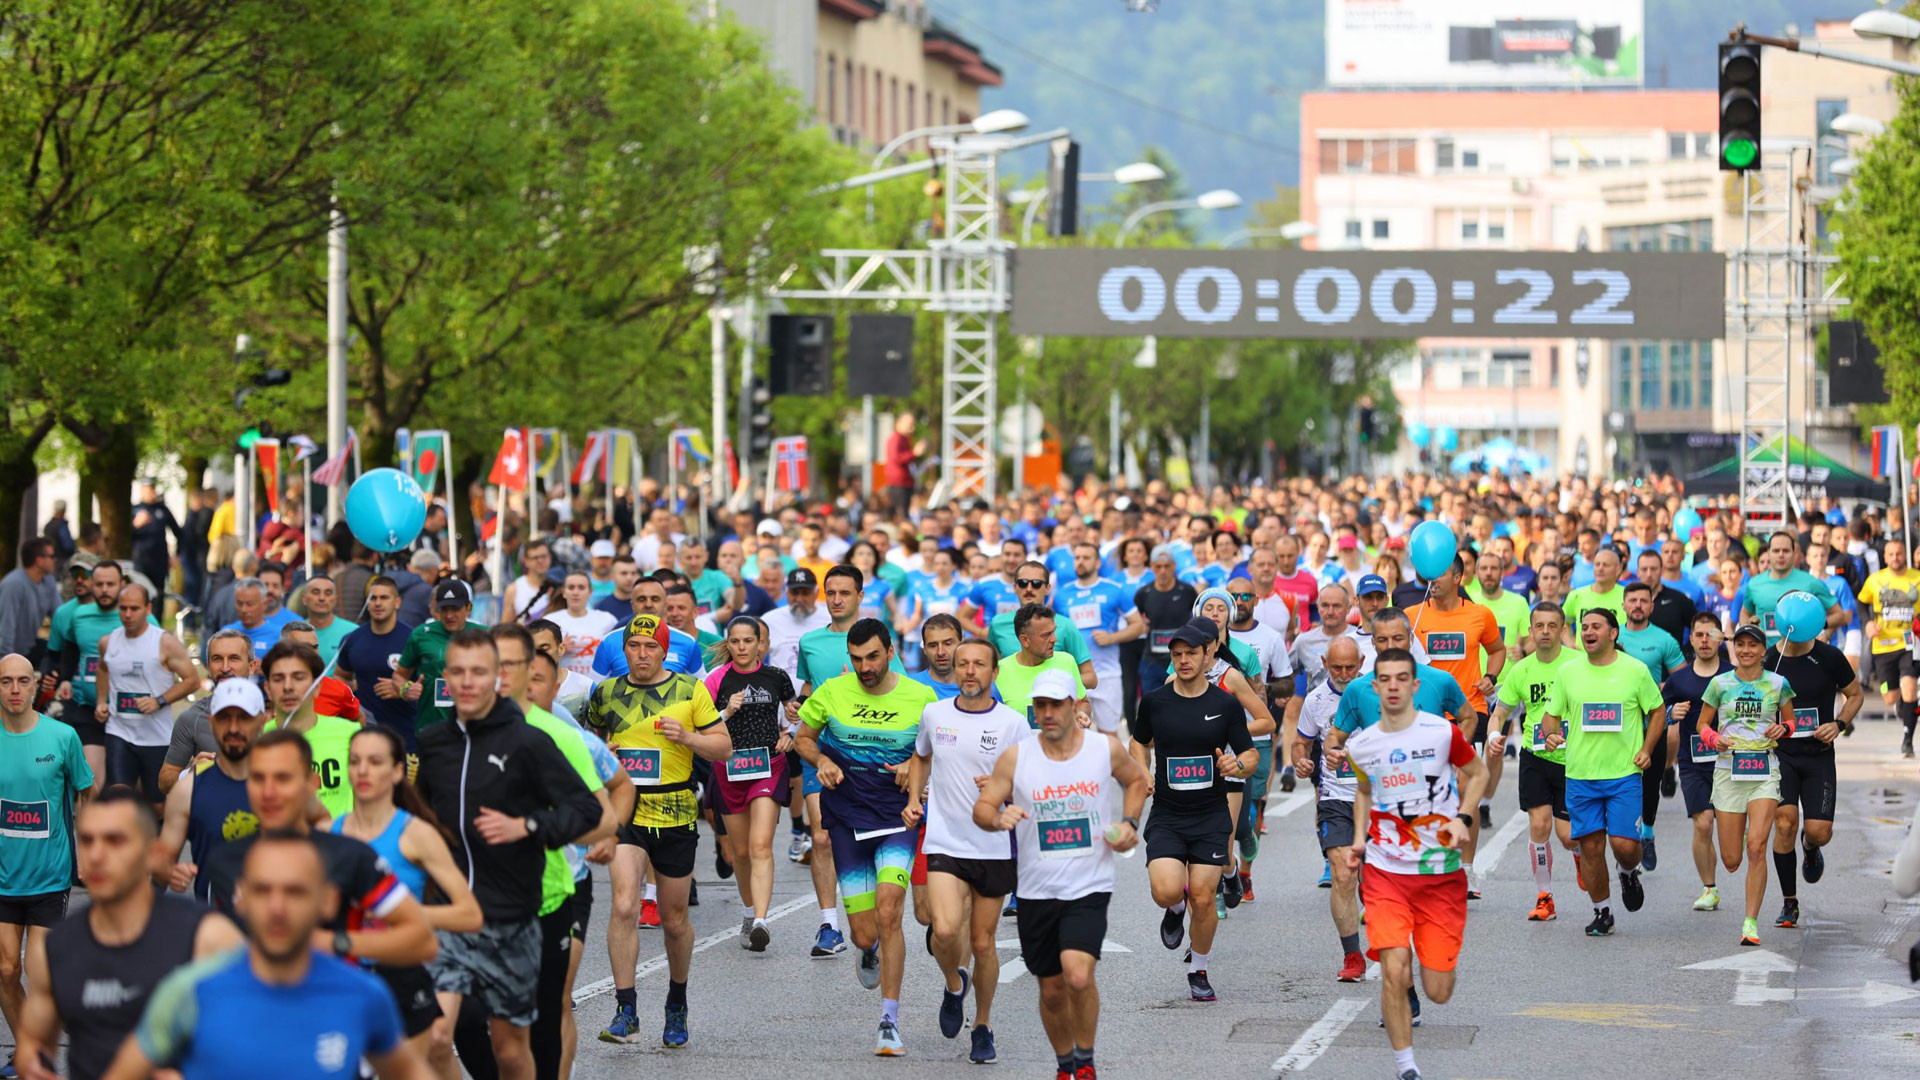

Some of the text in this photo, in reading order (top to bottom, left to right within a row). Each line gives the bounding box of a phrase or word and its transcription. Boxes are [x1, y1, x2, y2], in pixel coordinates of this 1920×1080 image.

[1098, 265, 1634, 325] 00:00:22
[1433, 639, 1459, 650] 2217
[1588, 709, 1616, 720] 2280
[1798, 716, 1812, 727] 43
[980, 735, 998, 745] NRC
[733, 755, 763, 769] 2014
[1738, 758, 1764, 769] 2336
[1175, 765, 1206, 778] 2016
[1381, 771, 1416, 789] 5084
[6, 810, 41, 824] 2004
[1046, 827, 1082, 844] 2021
